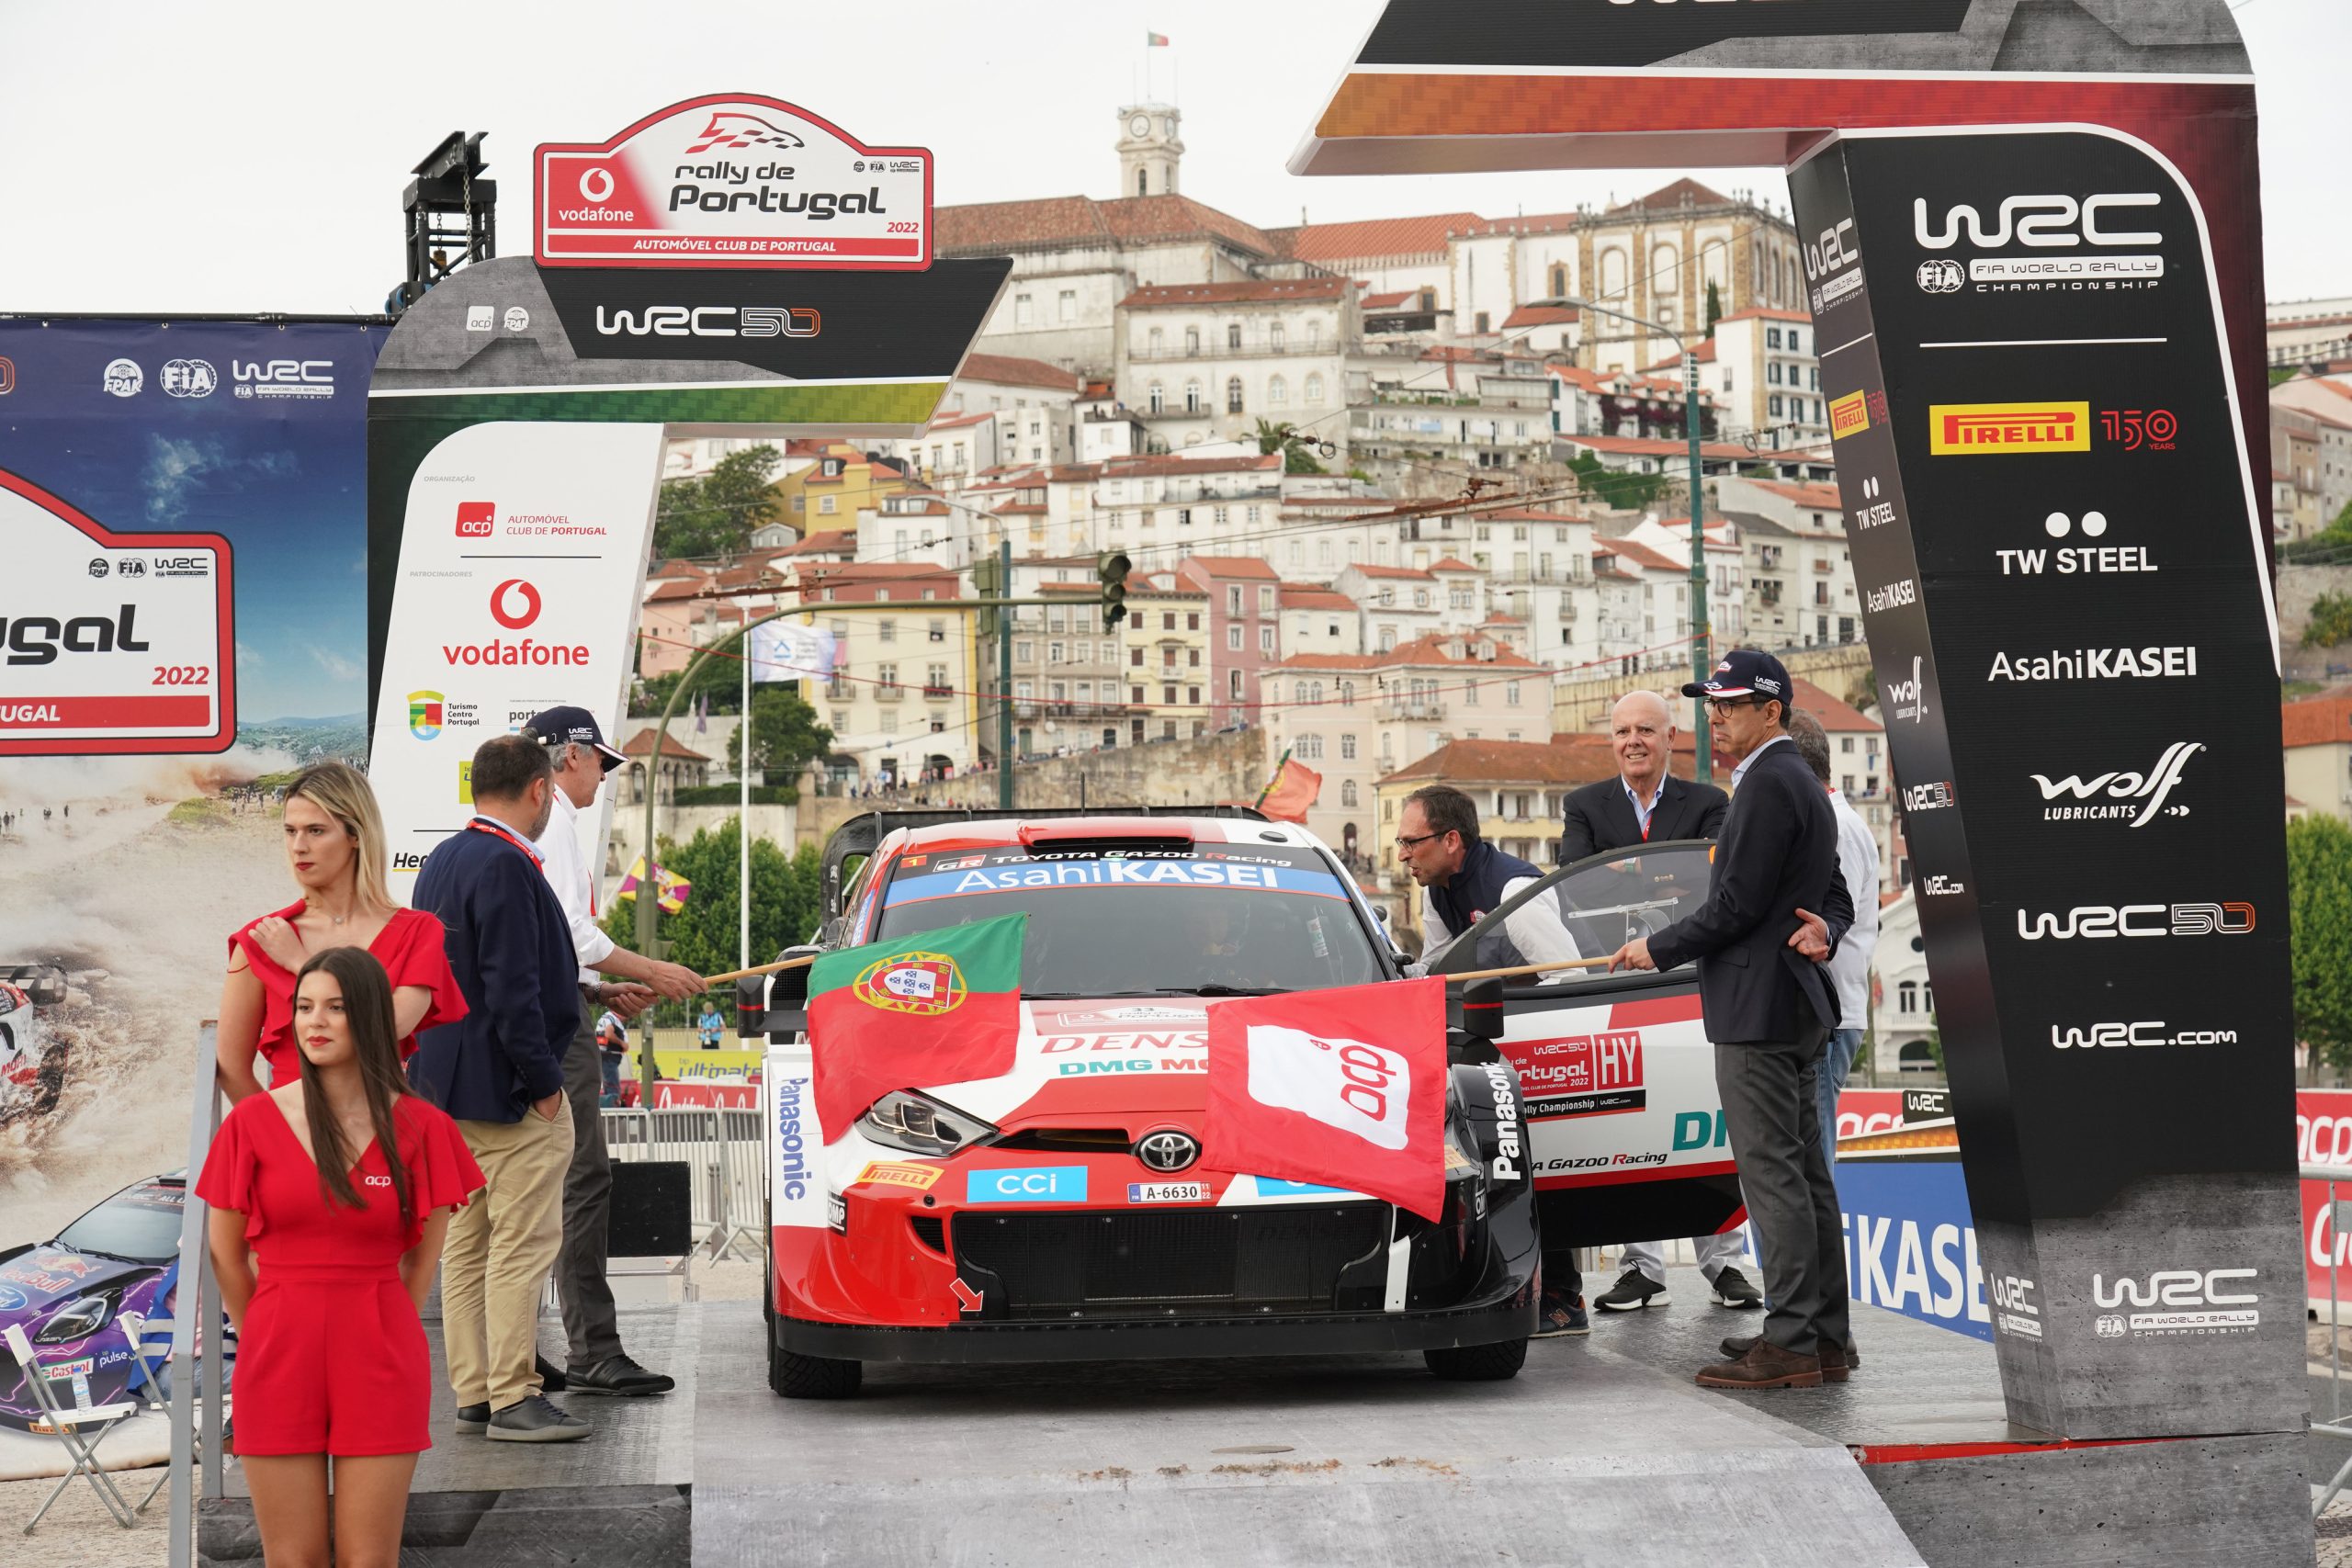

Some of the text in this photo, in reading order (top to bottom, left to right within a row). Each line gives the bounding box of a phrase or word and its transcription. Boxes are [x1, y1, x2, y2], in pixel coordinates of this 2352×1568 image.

[675, 162, 795, 185] rally de
[669, 185, 887, 220] Portugal
[559, 208, 634, 221] vodafone
[1914, 193, 2163, 250] WRC
[887, 221, 919, 232] 2022
[634, 238, 837, 253] AUTOMÓVEL CLUB DE PORTUGAL
[1803, 217, 1859, 281] WRC
[1976, 265, 2004, 274] FIA
[2011, 263, 2082, 274] WORLD
[2089, 262, 2158, 273] RALLY
[1976, 280, 2159, 292] CHAMPIONSHIP
[471, 320, 491, 329] acp
[232, 359, 334, 383] WRC
[103, 378, 142, 393] FPAK
[1833, 399, 1864, 431] PIRELLI
[1943, 411, 2076, 445] PIRELLI
[2149, 443, 2176, 451] YEARS
[424, 475, 475, 483] ORGANIZAÇÃO
[508, 513, 570, 525] AUTOMÓVEL
[1856, 502, 1895, 530] TW STEEL
[461, 521, 492, 535] acp
[506, 526, 607, 536] CLUB DE PORTUGAL
[155, 558, 208, 569] WRC
[1996, 547, 2158, 575] TW STEEL
[443, 638, 590, 666] vodafone
[152, 666, 209, 685] 2022
[1756, 675, 1781, 690] WRC
[0, 705, 61, 722] UGAL
[509, 710, 537, 723] port
[448, 718, 480, 727] Portugal
[2030, 742, 2203, 827] wolf
[2044, 805, 2136, 820] LUBRICANTS
[908, 858, 918, 866] 1
[937, 859, 981, 872] GR
[992, 850, 1292, 867] TOYOTA GAZOO Racing
[2052, 1021, 2237, 1049] WRC.com
[1059, 1059, 1153, 1076] DMG
[1600, 1036, 1637, 1085] HY
[1518, 1060, 1589, 1082] rtugal
[1570, 1077, 1589, 1087] 2022
[1539, 1099, 1595, 1114] Championship
[1908, 1093, 1944, 1112] WRC
[1548, 1156, 1609, 1169] GAZOO
[1612, 1152, 1668, 1166] Racing
[365, 1176, 391, 1188] acp
[862, 1164, 933, 1186] PIRELLI
[1147, 1186, 1198, 1200] A-6630
[828, 1201, 845, 1225] OMP
[1990, 1271, 2039, 1315] WRC
[2093, 1269, 2258, 1308] WRC
[2157, 1315, 2205, 1324] WORLD
[2209, 1314, 2256, 1323] RALLY
[2134, 1326, 2256, 1337] CHAMPIONSHIP
[99, 1351, 128, 1369] pulse
